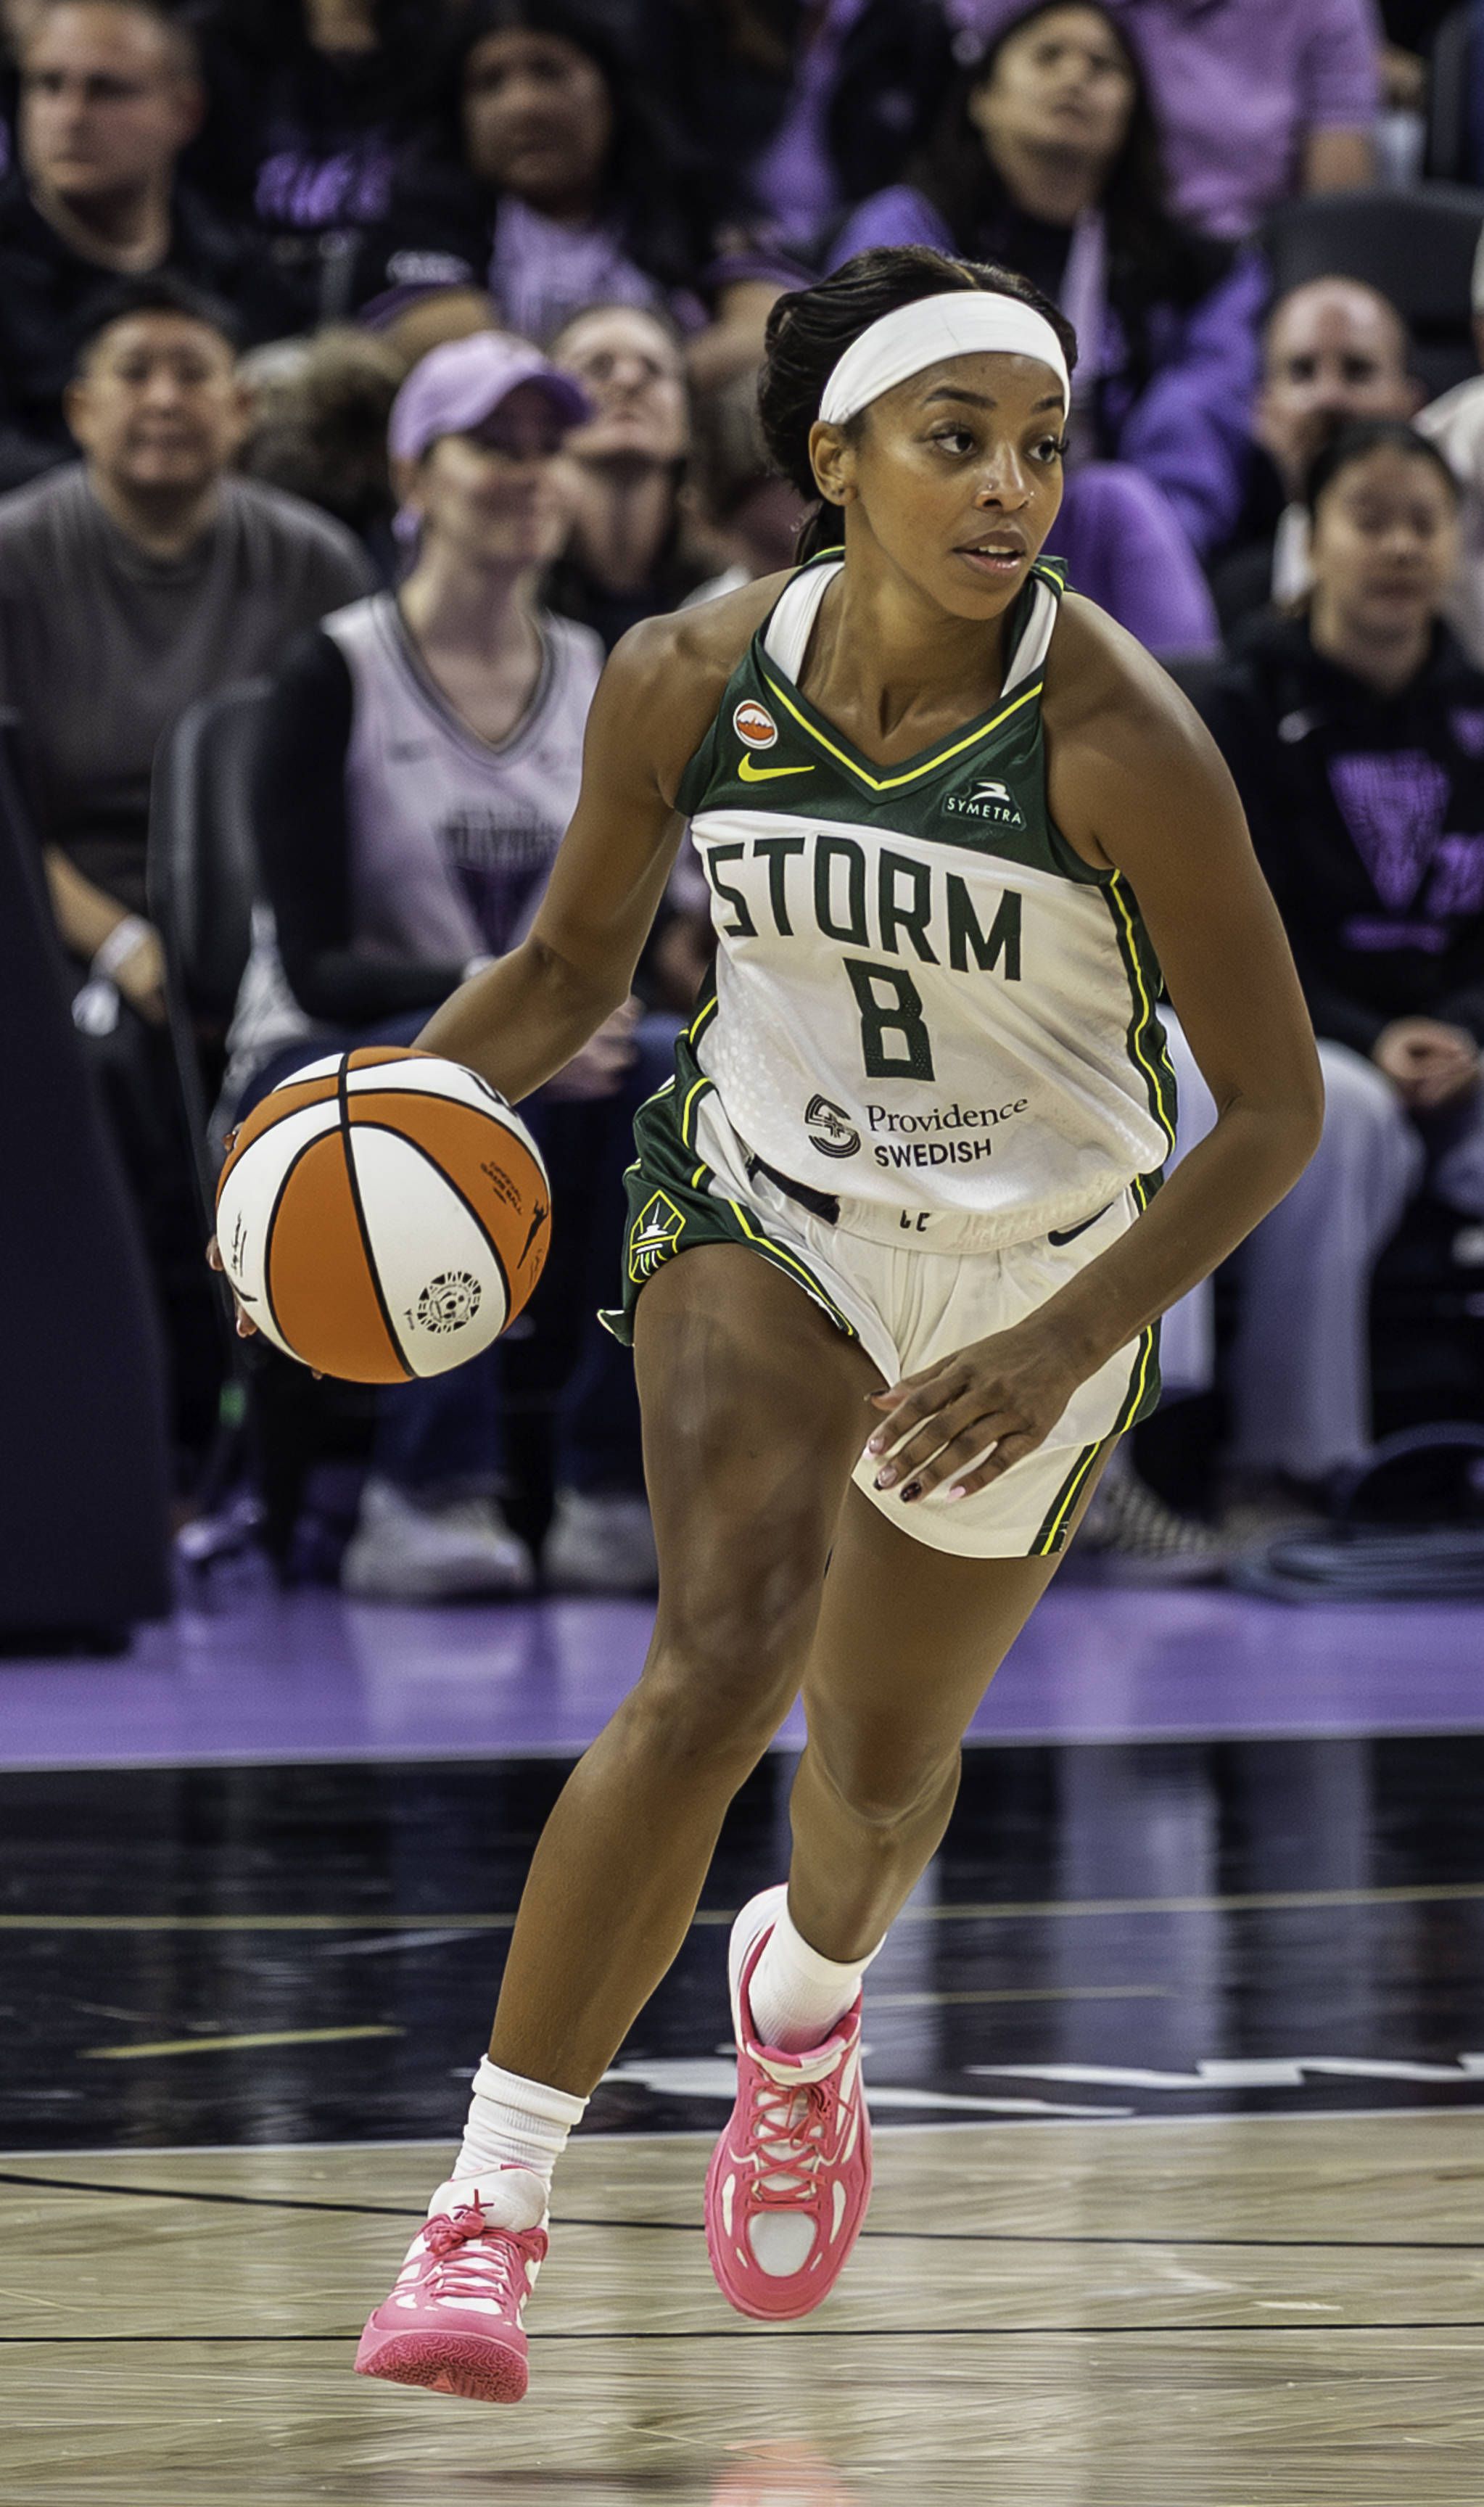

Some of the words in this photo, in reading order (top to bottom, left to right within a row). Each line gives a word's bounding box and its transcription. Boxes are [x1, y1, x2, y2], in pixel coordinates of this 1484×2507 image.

[947, 797, 1021, 824] SYMETRA
[706, 834, 1022, 981] STORM
[842, 957, 936, 1082] 8
[866, 1098, 1029, 1133] Providence
[874, 1137, 992, 1168] SWEDISH
